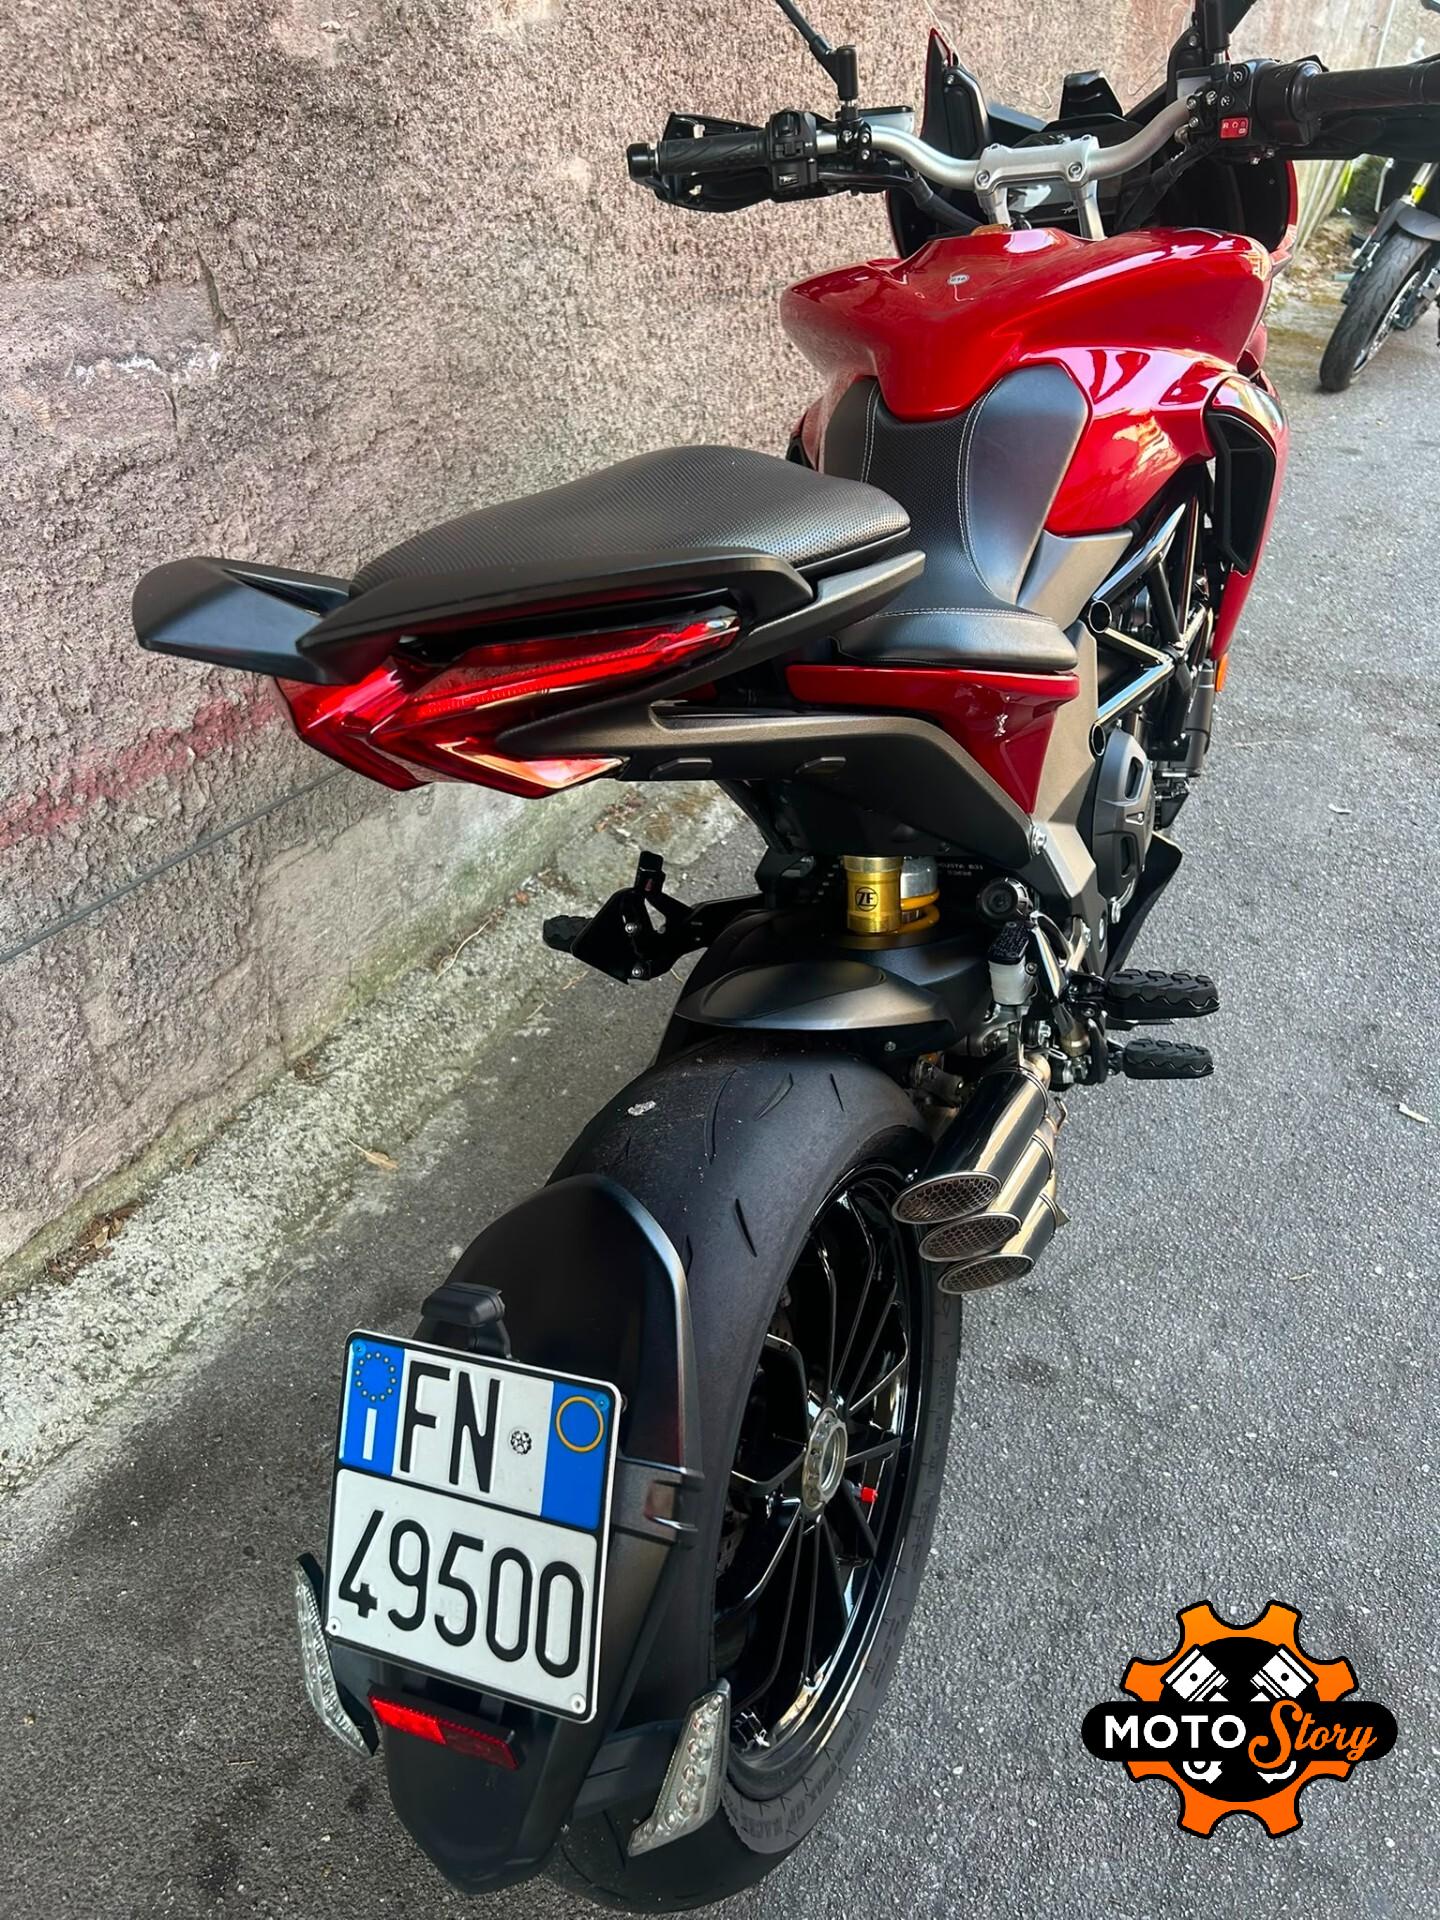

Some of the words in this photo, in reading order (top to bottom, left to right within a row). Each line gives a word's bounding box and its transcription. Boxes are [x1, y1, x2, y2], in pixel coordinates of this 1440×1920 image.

[856, 890, 877, 908] ZF
[399, 1360, 500, 1494] FN
[338, 1509, 584, 1679] 49500
